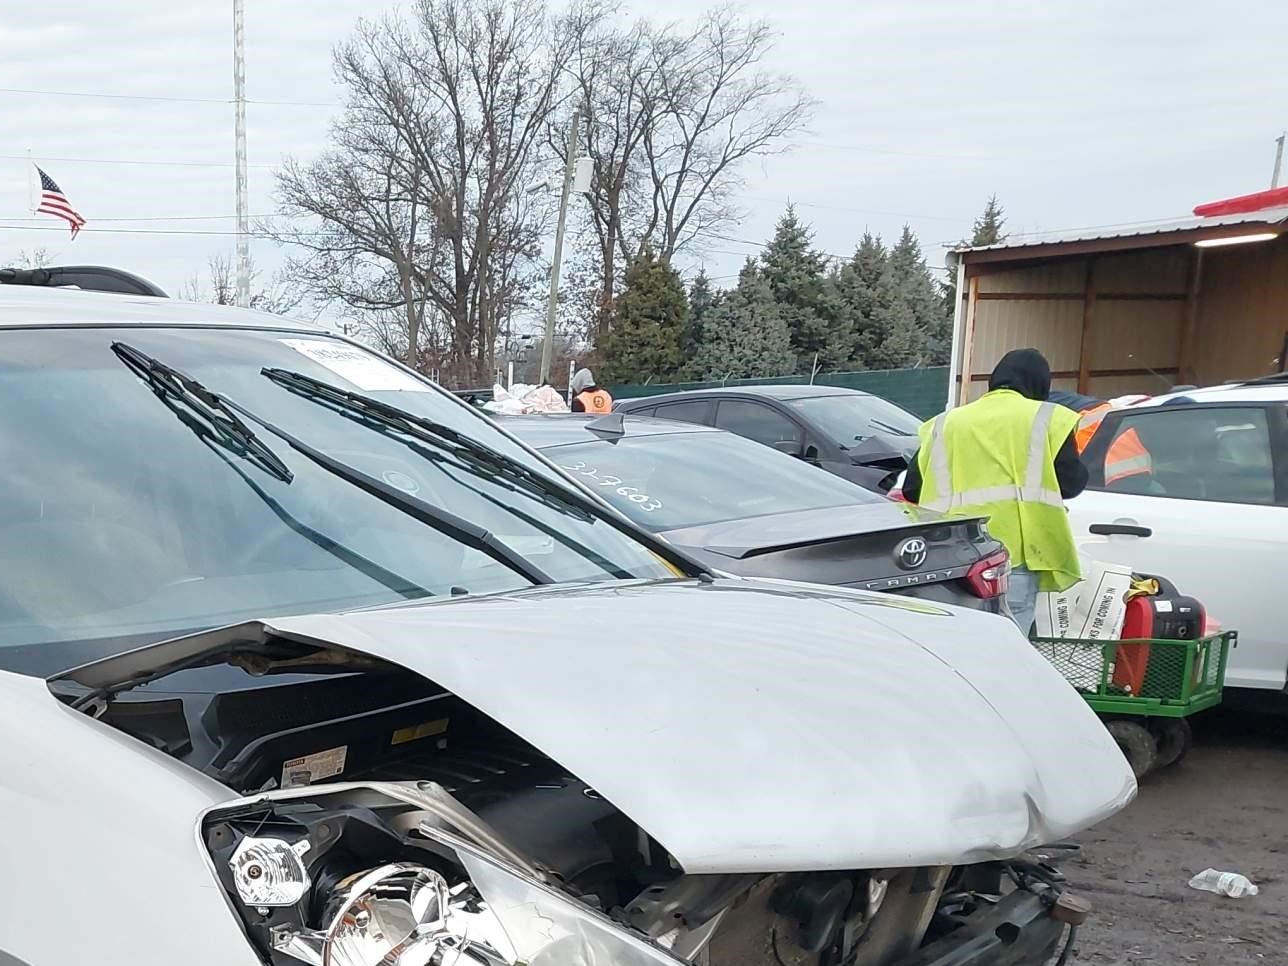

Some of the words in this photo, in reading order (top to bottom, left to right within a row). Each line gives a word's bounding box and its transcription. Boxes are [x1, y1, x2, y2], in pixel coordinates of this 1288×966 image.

[866, 570, 953, 590] CAMRY
[1057, 605, 1069, 628] COMING
[1096, 594, 1114, 618] COMING
[1092, 617, 1105, 630] FOR
